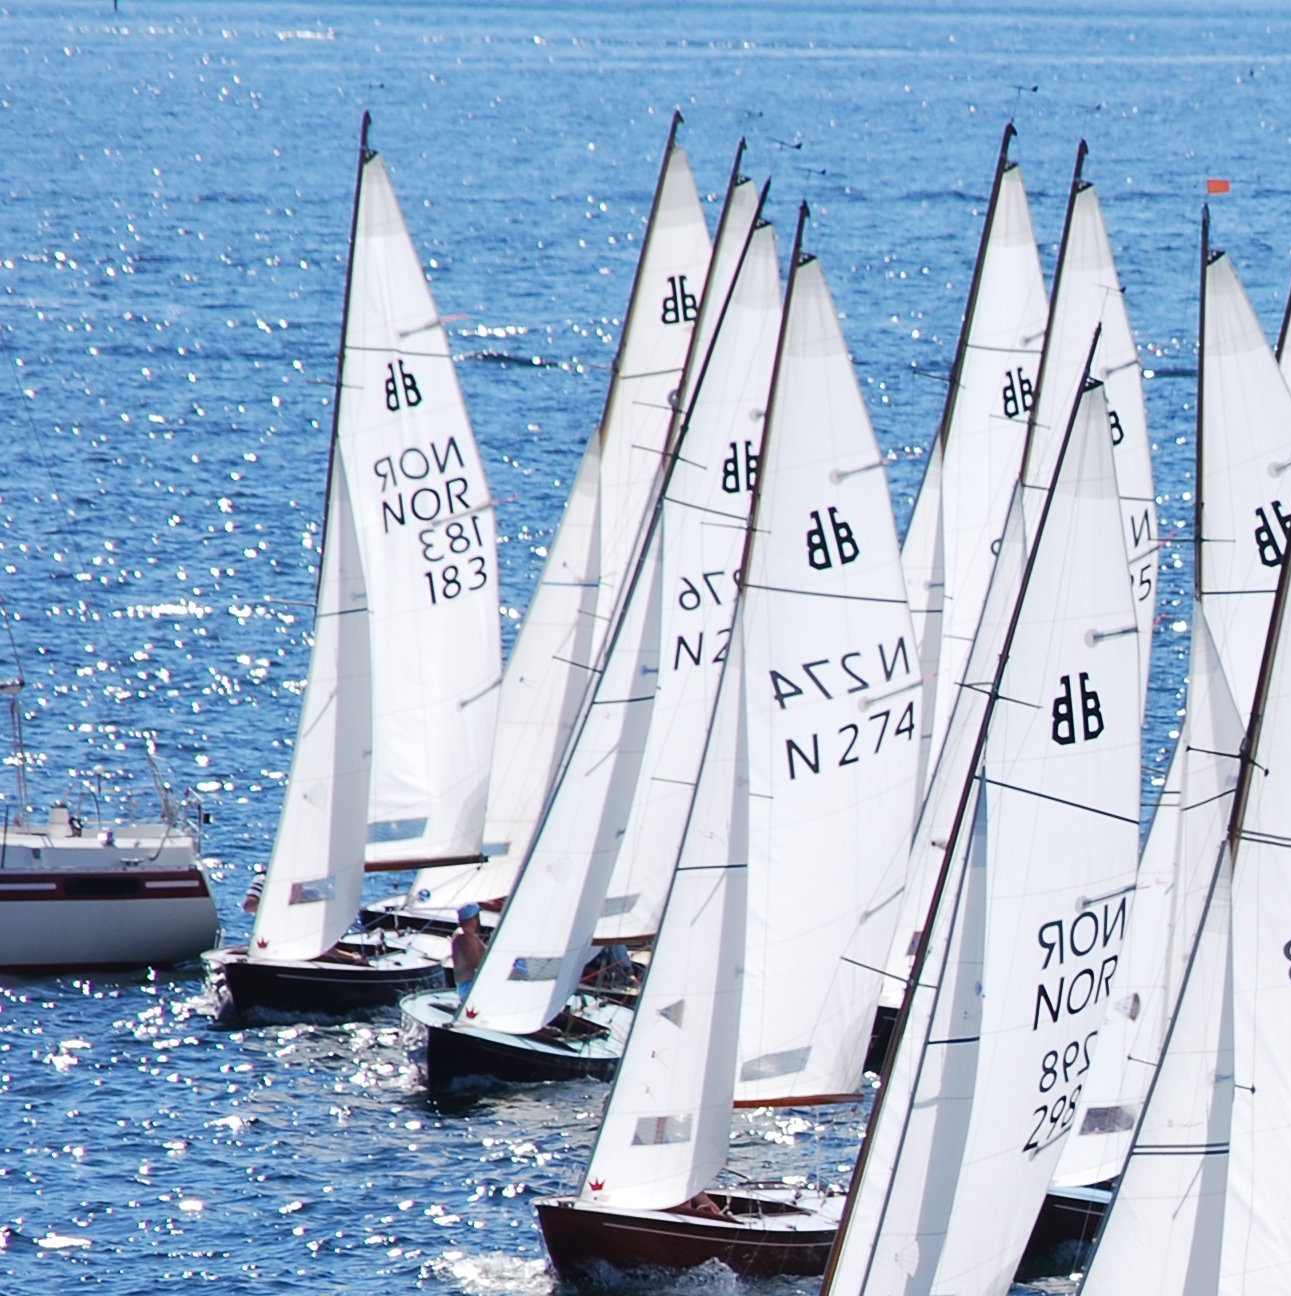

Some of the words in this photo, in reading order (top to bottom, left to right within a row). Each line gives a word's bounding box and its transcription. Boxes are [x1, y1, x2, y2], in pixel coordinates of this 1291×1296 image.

[382, 477, 470, 534] NOR
[424, 556, 487, 605] 183
[673, 631, 704, 671] N
[786, 733, 820, 780] N
[838, 701, 915, 768] 274
[1032, 954, 1119, 1031] NOR
[1023, 1083, 1083, 1151] 298
